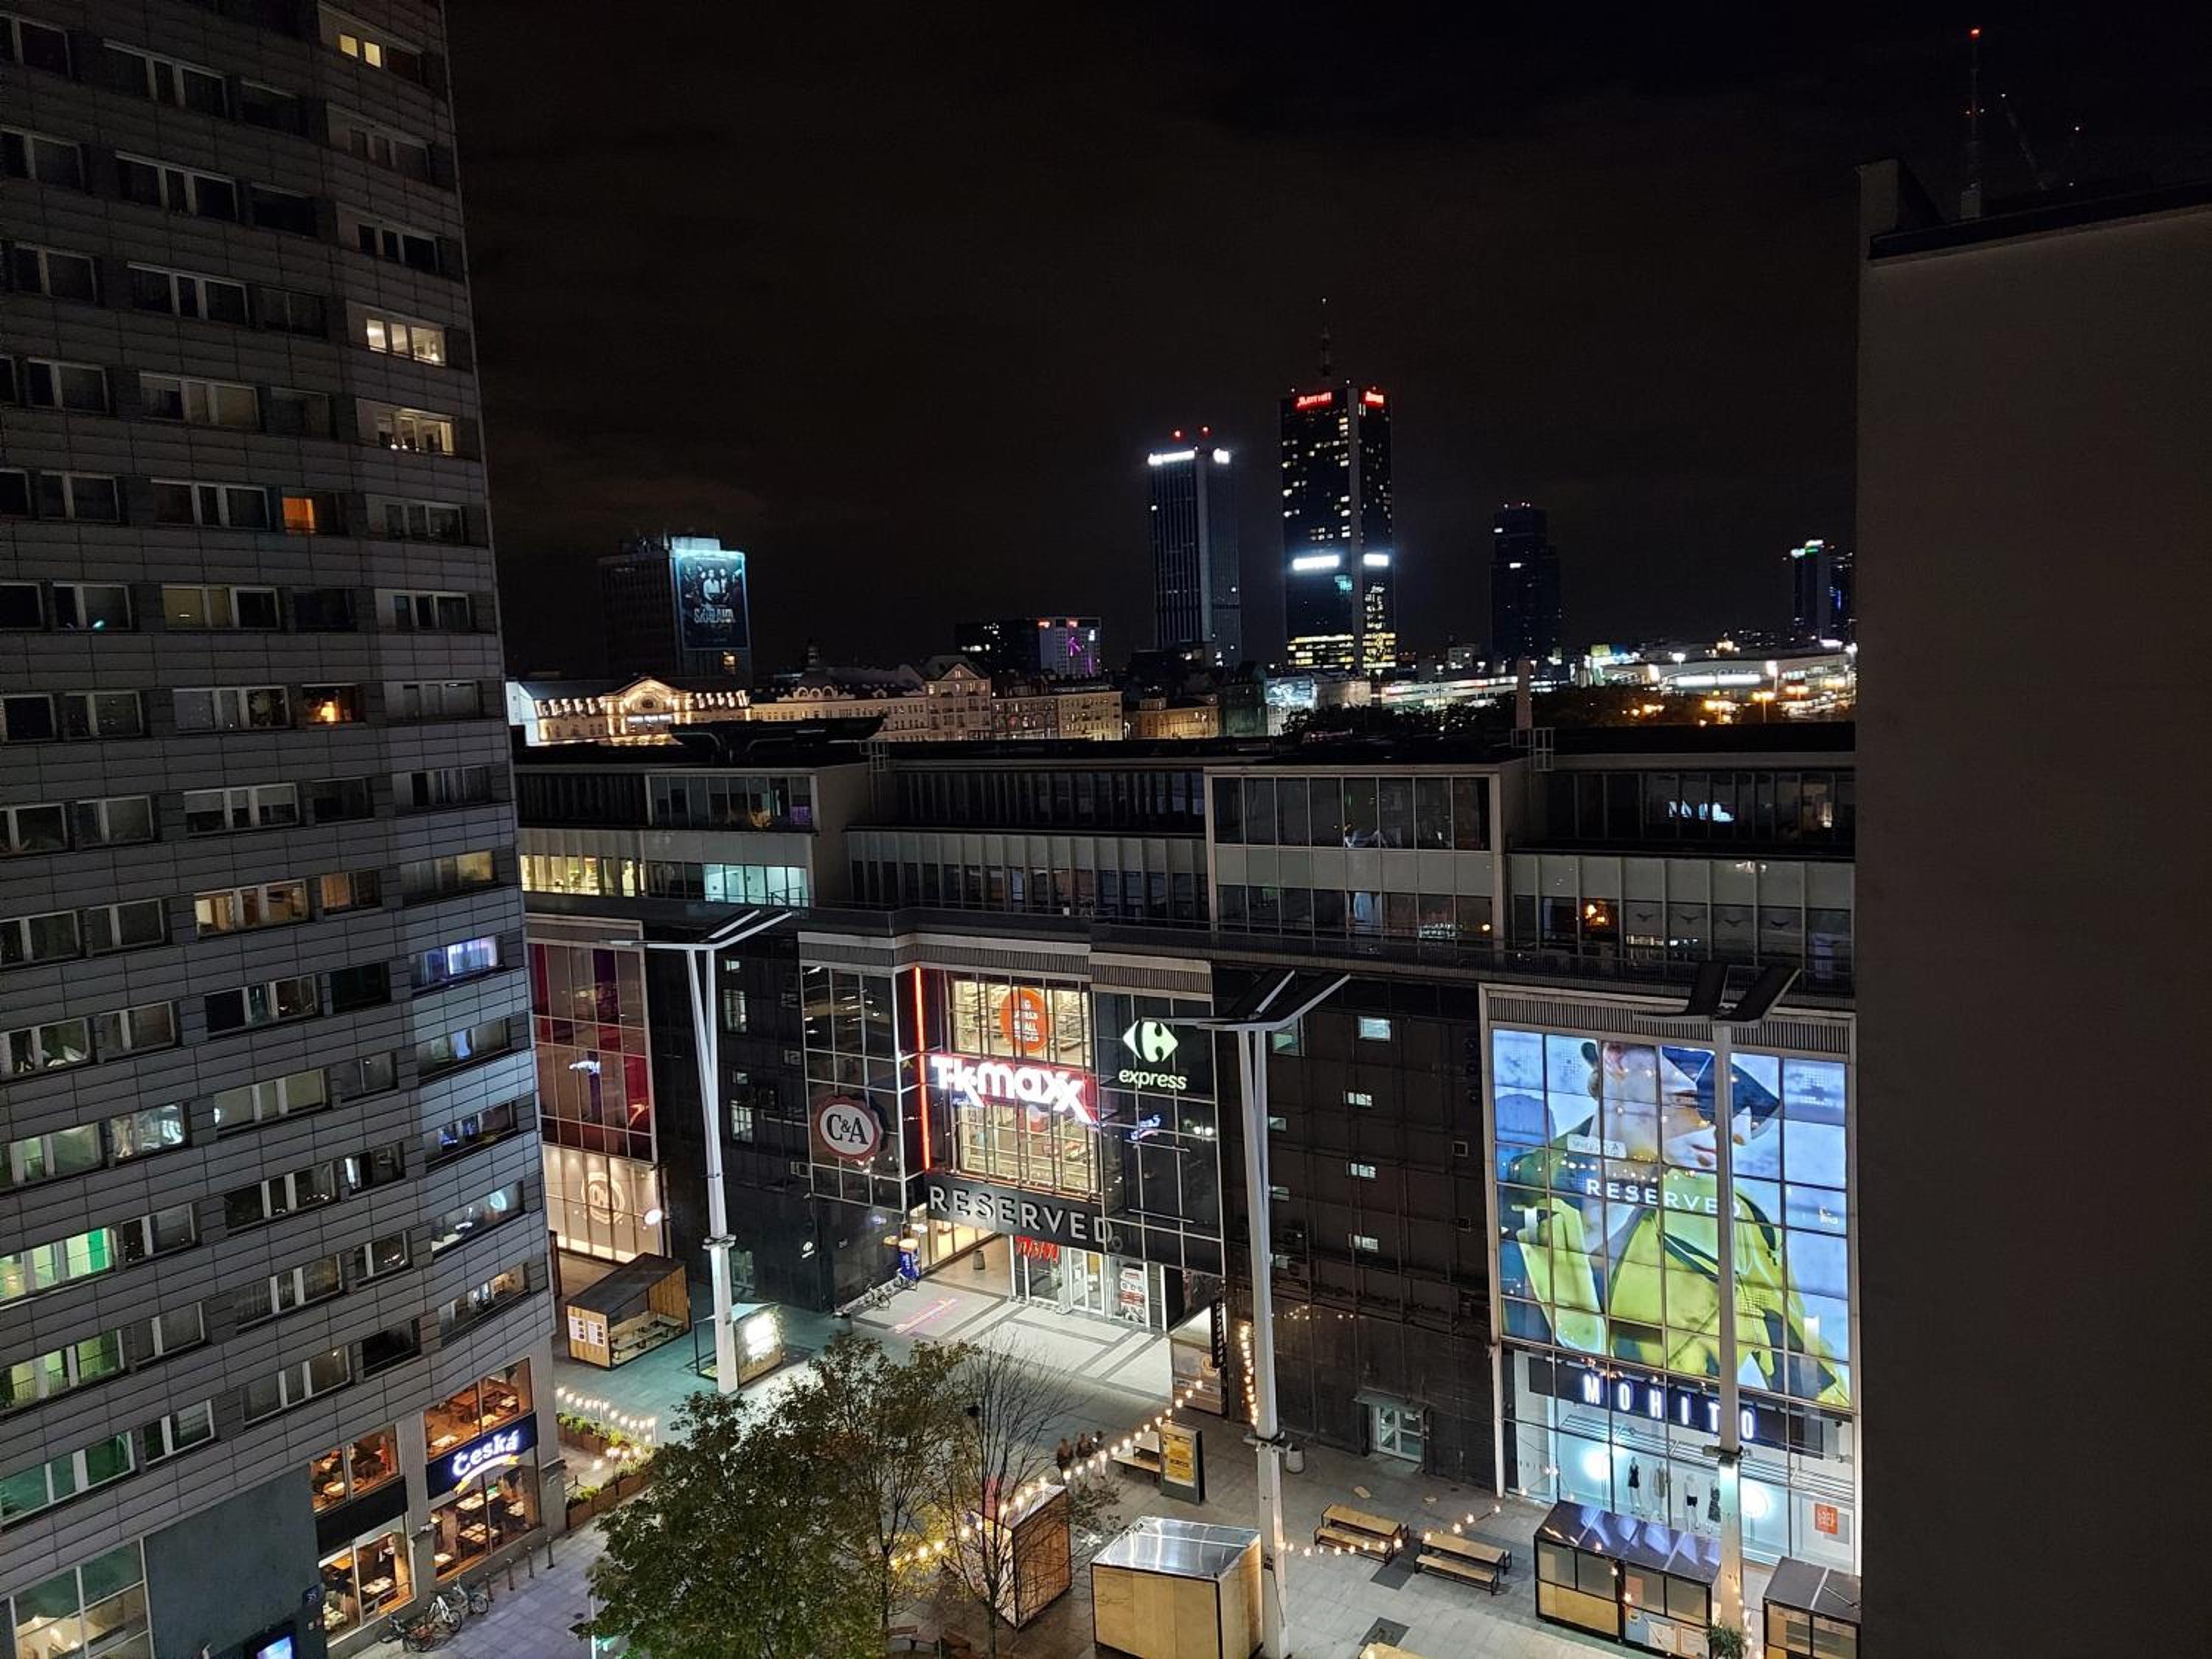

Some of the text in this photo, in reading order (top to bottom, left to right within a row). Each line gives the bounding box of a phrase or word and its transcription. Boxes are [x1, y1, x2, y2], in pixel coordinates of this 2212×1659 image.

[1119, 1068, 1188, 1091] express
[826, 1113, 869, 1145] C&A
[929, 1185, 1114, 1245] RESERVED
[1583, 1373, 1756, 1440] MOHITO
[452, 1429, 520, 1476] Česká
